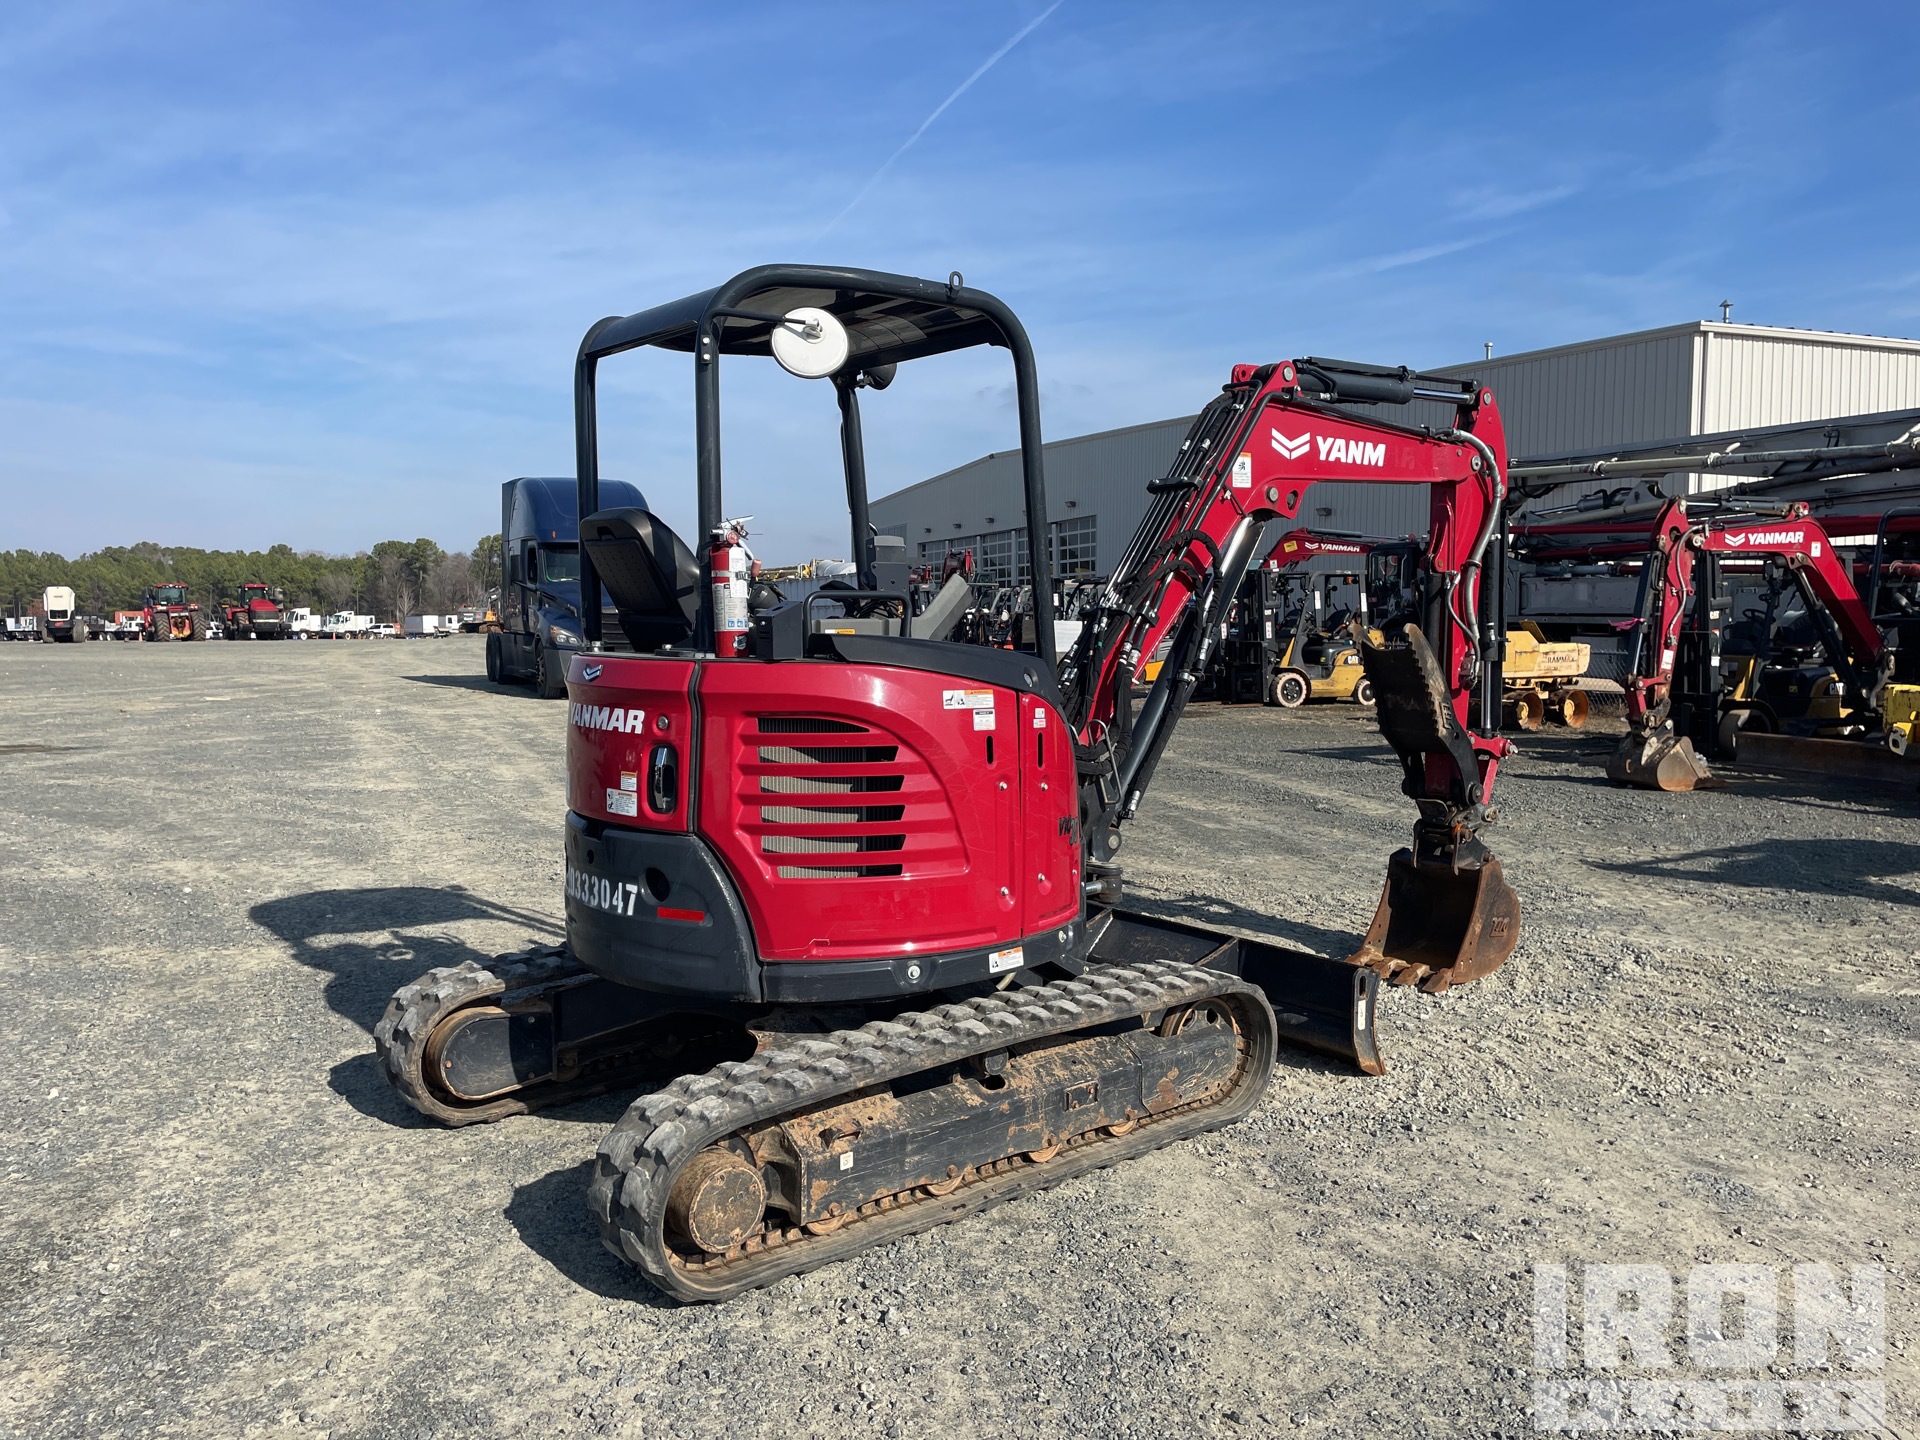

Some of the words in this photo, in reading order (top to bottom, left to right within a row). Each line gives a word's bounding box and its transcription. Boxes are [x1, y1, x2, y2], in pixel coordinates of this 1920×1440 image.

[1315, 435, 1386, 467] YANM
[1748, 531, 1804, 546] YANMAR
[1320, 543, 1361, 552] YANMAR
[1347, 655, 1359, 664] CAT
[1829, 682, 1845, 695] CAT
[570, 702, 645, 734] YANMAR
